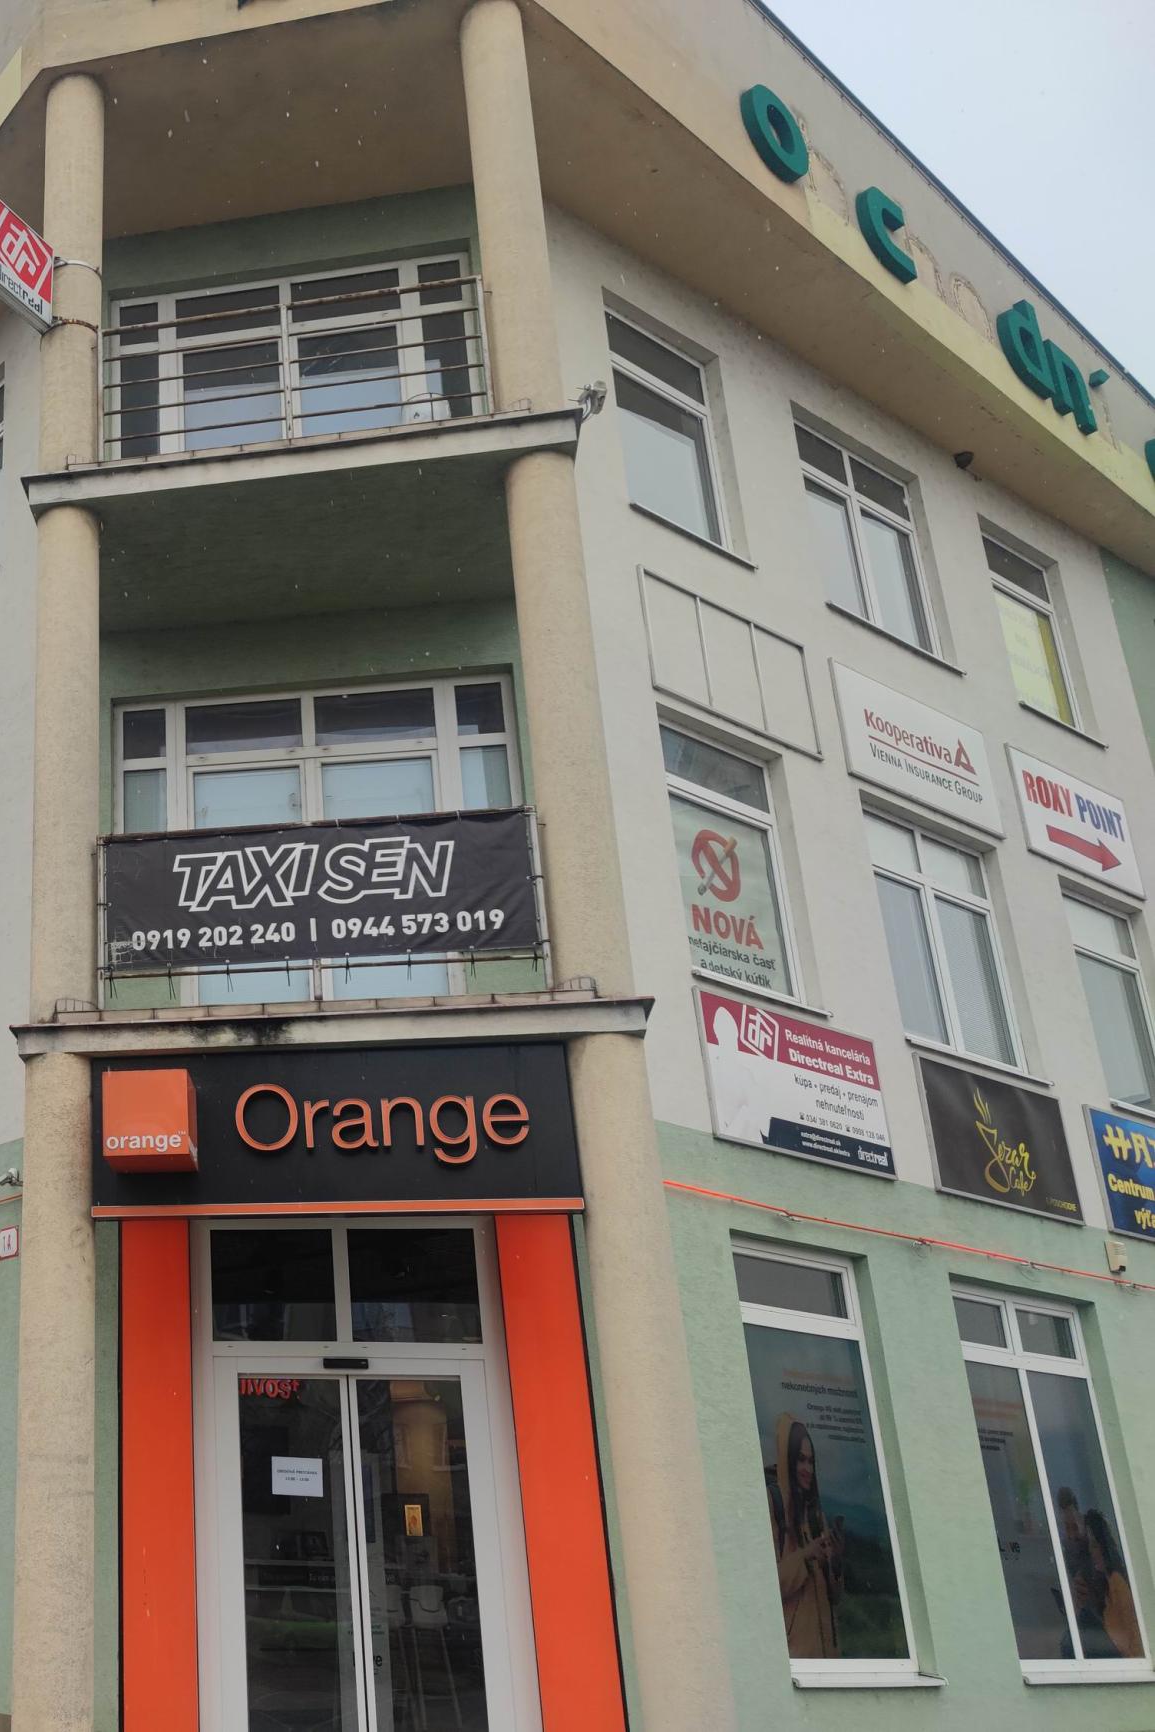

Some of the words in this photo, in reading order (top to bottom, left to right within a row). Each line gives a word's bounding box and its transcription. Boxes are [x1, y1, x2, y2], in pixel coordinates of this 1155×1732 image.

[863, 708, 953, 765] Kooperativa
[1021, 769, 1074, 818] ROXY
[1074, 793, 1126, 843] POINT
[173, 842, 319, 912] TAXI
[318, 836, 455, 905] SEN
[131, 927, 191, 952] 0919
[198, 924, 244, 948] 202
[250, 921, 296, 945] 240
[331, 915, 395, 939] 0944
[401, 911, 450, 934] 573
[456, 908, 505, 932] 019
[691, 903, 765, 950] NOVÁ
[700, 958, 708, 969] a
[745, 970, 772, 990] kútik
[785, 1029, 824, 1051] Realitná
[824, 1038, 872, 1066] kancelária
[788, 1048, 844, 1076] Directreal
[845, 1066, 875, 1086] Extra
[106, 1131, 182, 1153] orange
[234, 1083, 530, 1165] Orange
[1107, 1173, 1155, 1201] Centrum
